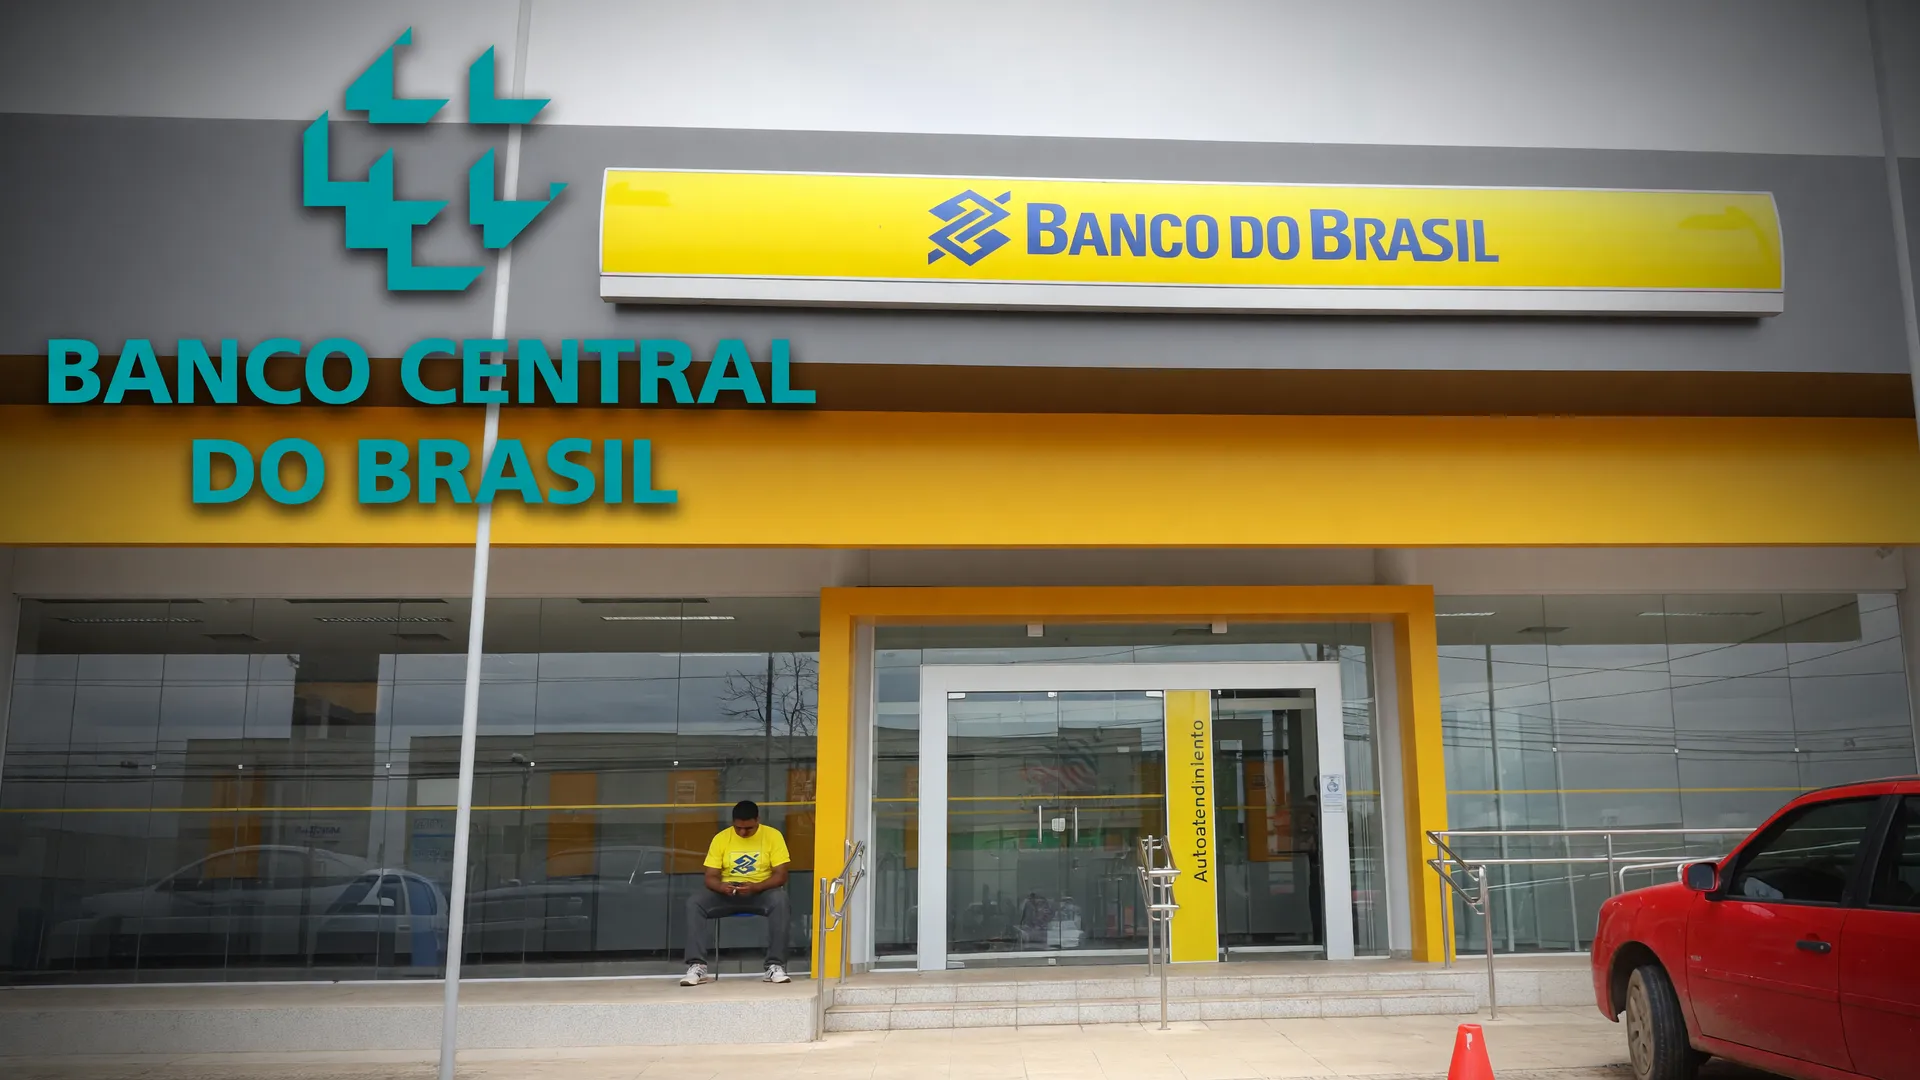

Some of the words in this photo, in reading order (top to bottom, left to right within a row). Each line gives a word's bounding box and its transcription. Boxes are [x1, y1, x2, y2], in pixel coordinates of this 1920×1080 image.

[1027, 203, 1219, 259] BANCO
[1230, 216, 1300, 260] DO
[1310, 209, 1498, 262] BRASIL
